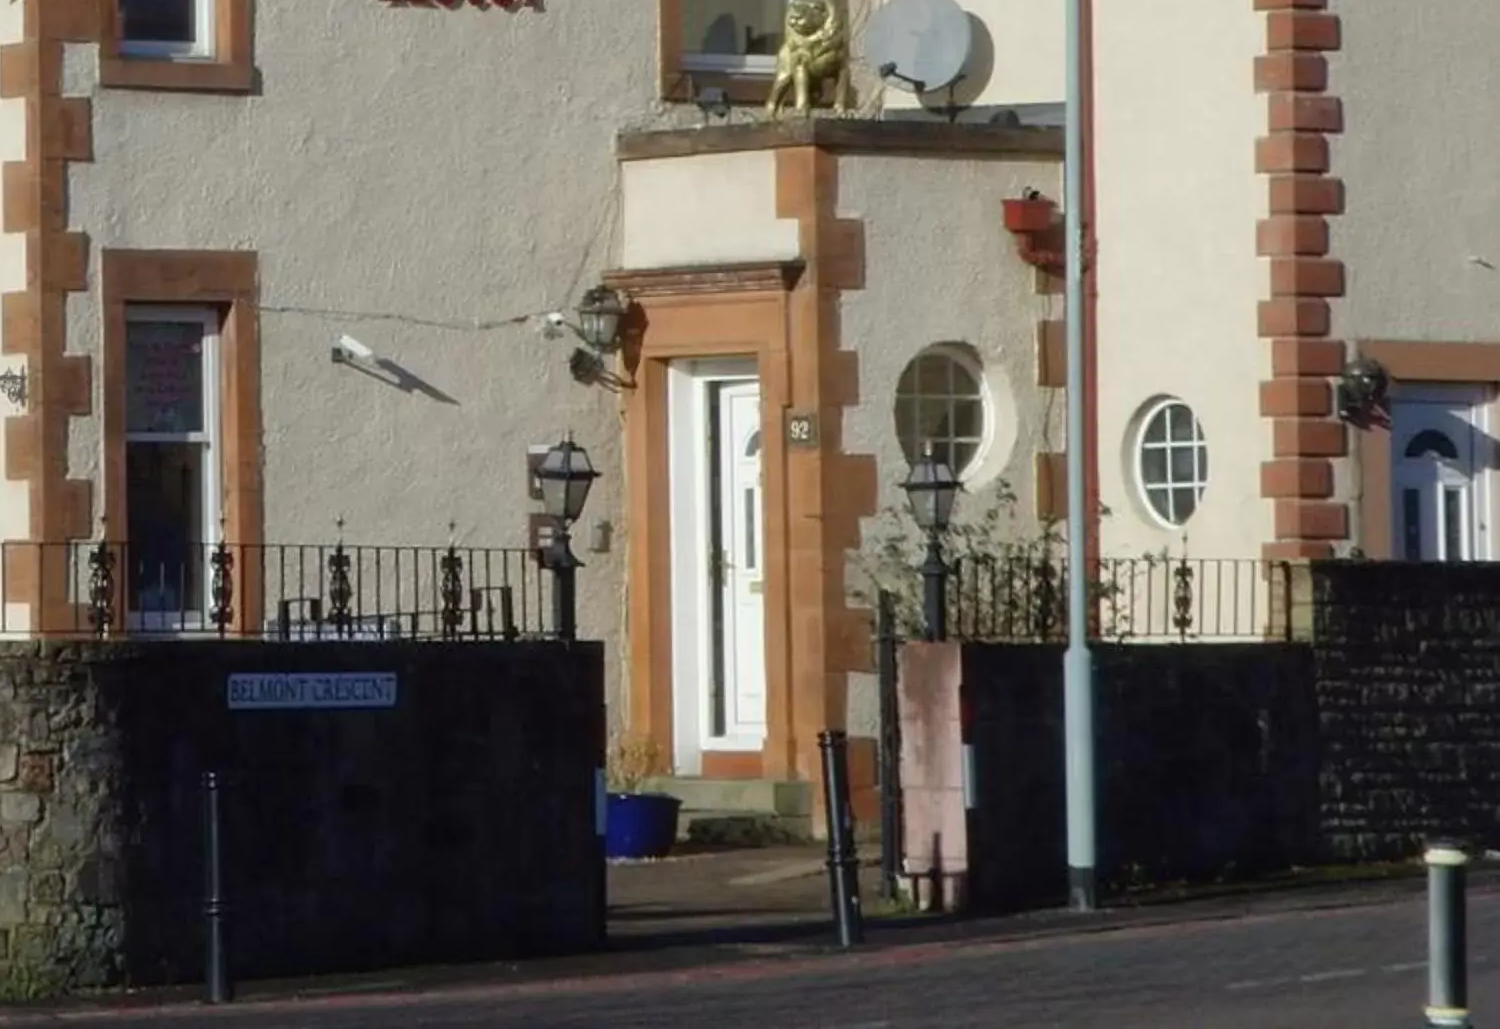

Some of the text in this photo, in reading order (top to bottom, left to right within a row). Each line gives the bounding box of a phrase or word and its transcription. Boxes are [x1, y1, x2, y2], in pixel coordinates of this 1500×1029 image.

[790, 420, 809, 440] 92
[231, 677, 396, 702] BELMONT CRESCENT
